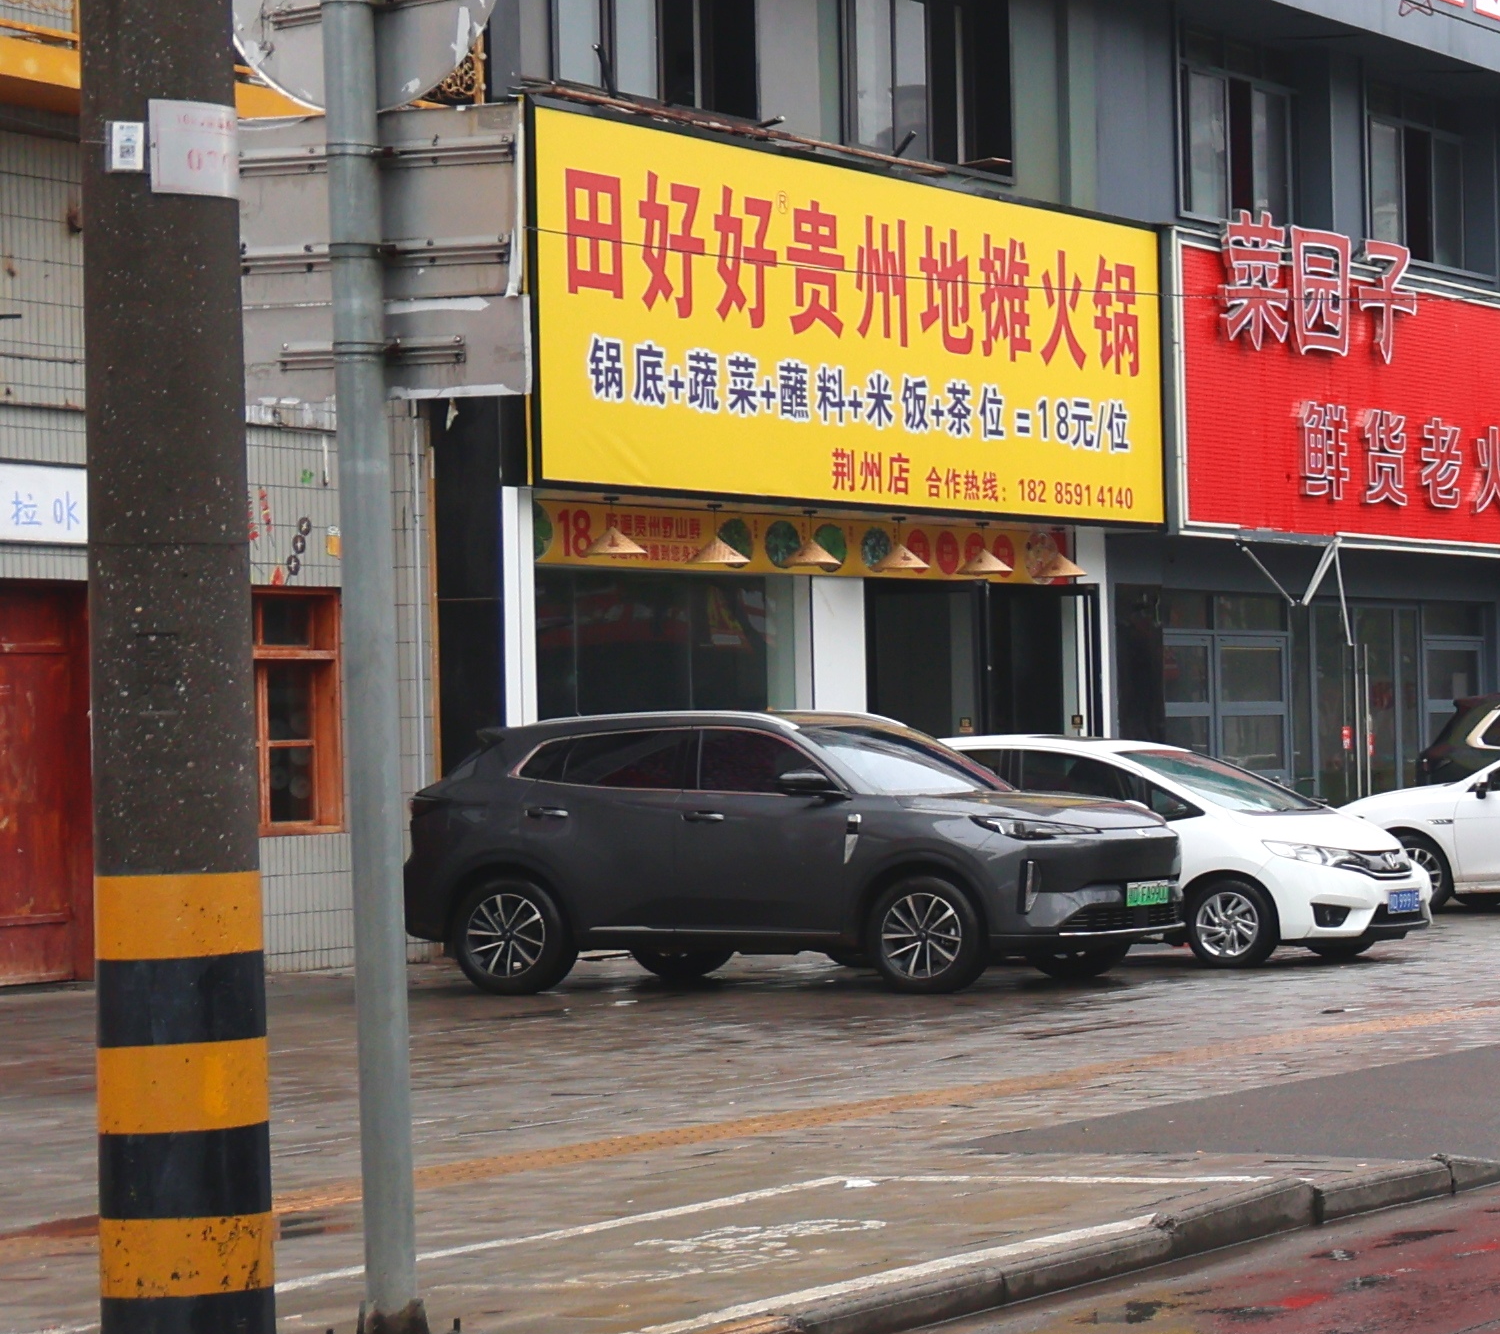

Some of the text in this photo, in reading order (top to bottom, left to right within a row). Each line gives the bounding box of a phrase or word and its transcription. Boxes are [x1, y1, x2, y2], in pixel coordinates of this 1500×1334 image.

[1221, 210, 1418, 365] 菜园子
[831, 447, 911, 496] 荆州店
